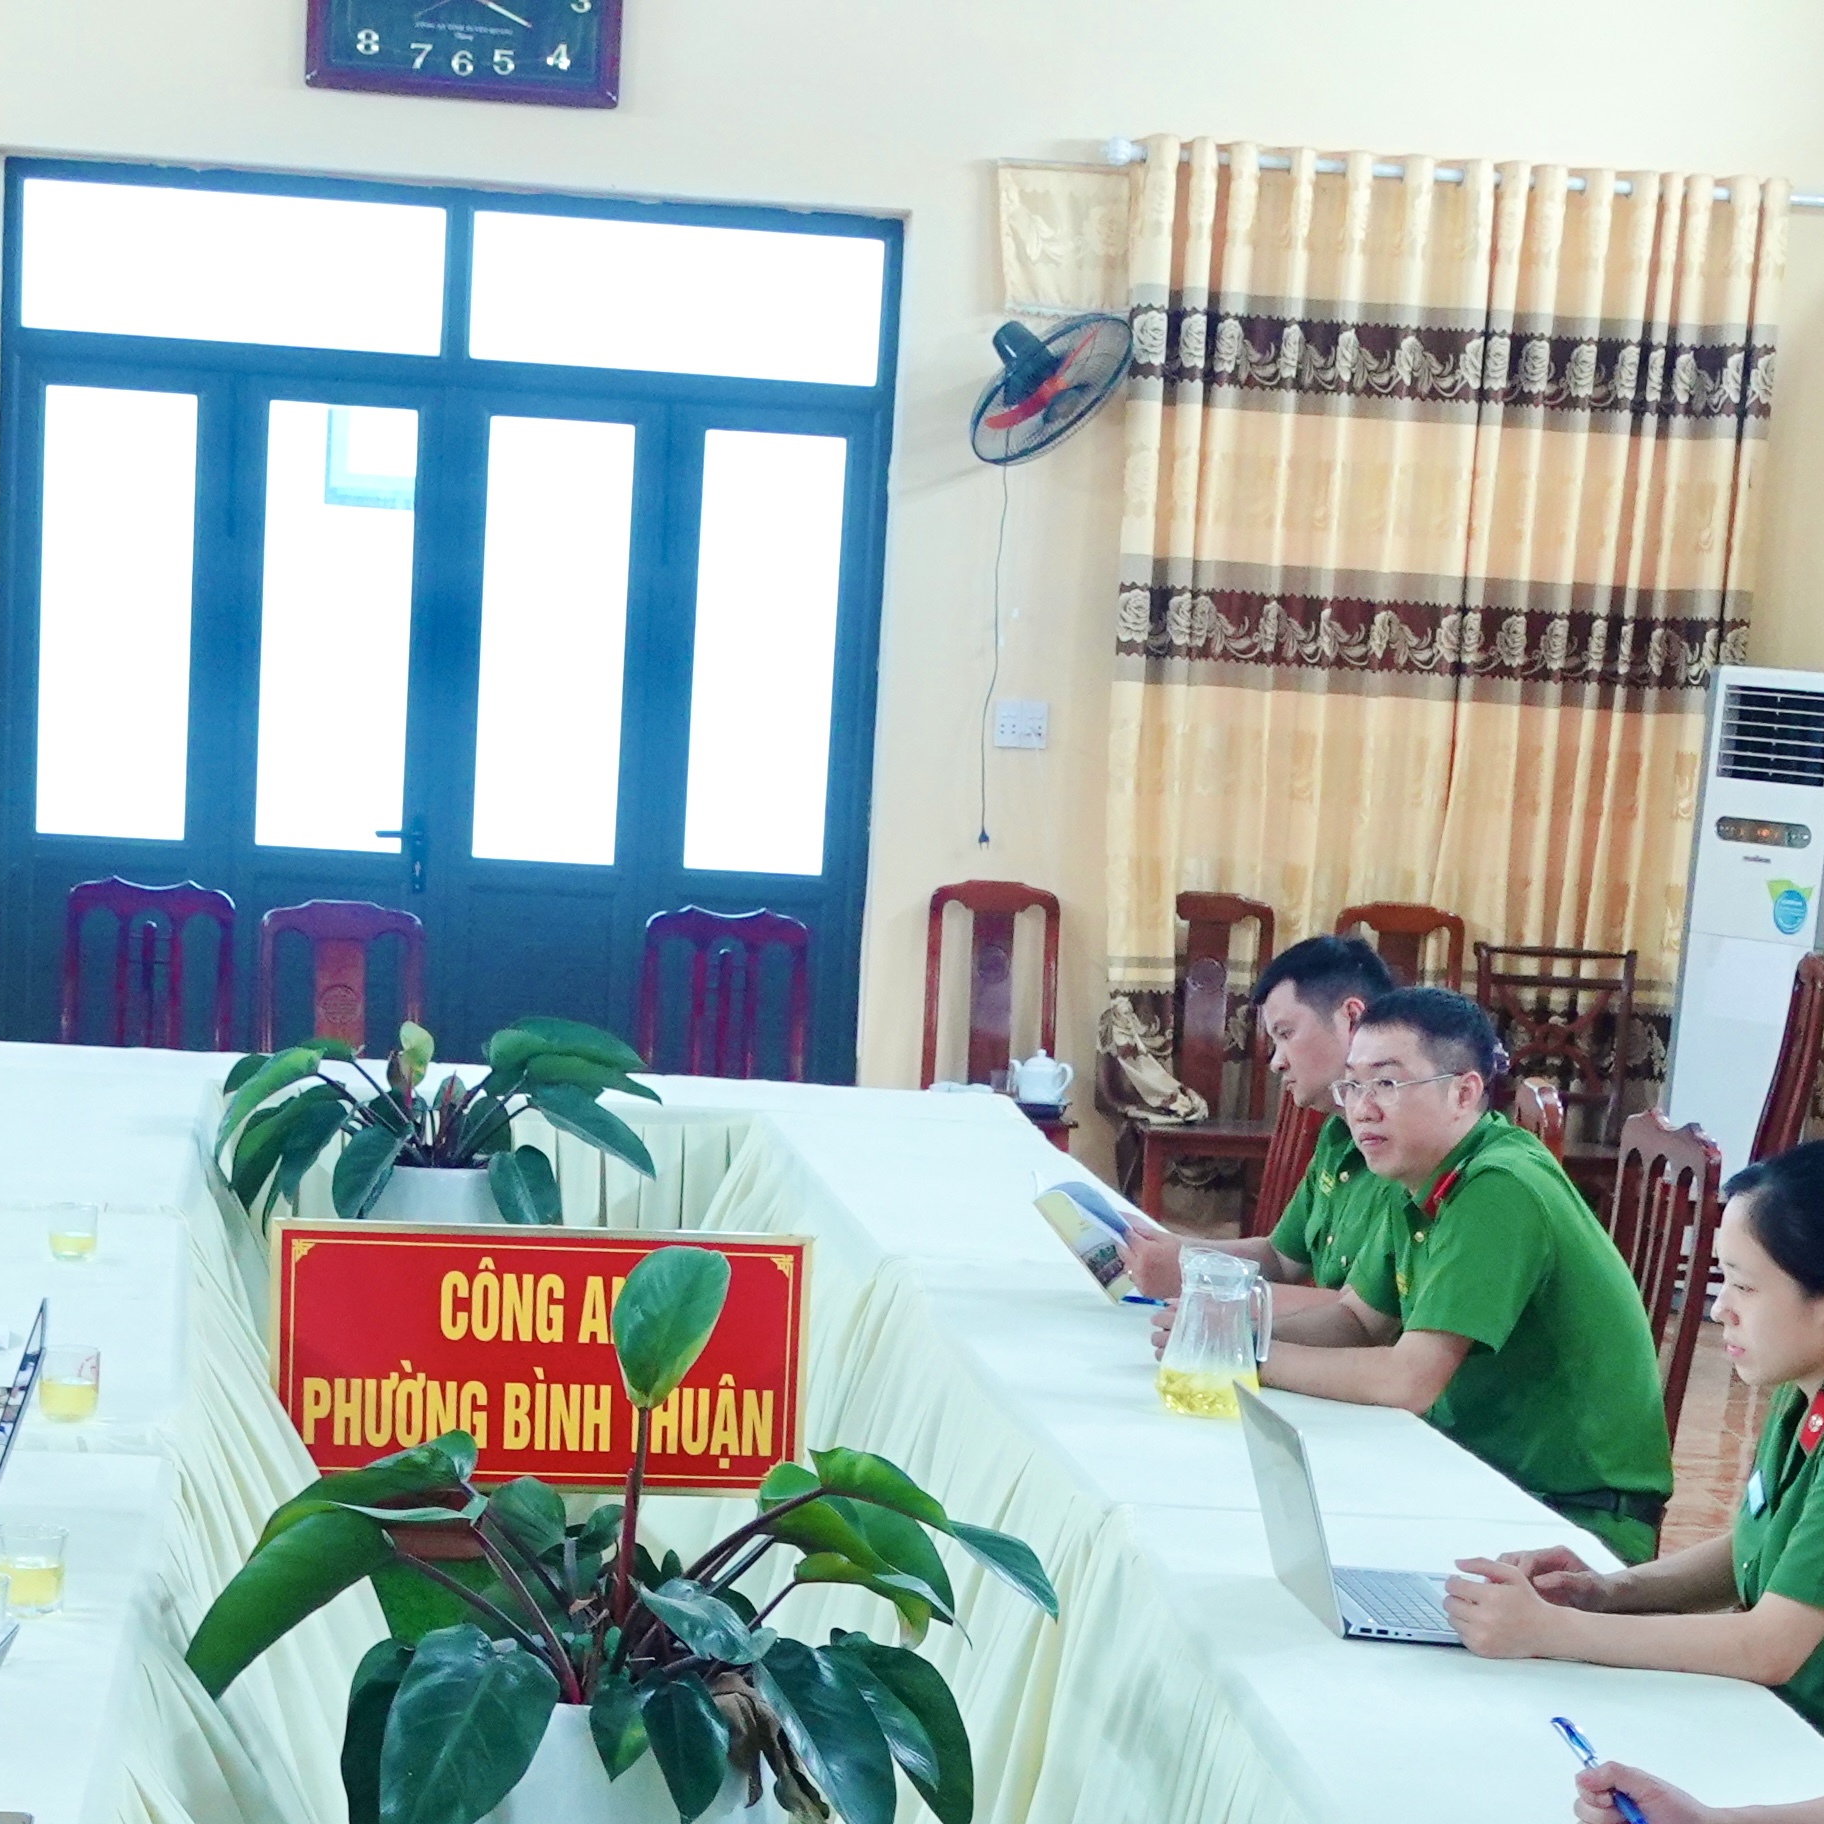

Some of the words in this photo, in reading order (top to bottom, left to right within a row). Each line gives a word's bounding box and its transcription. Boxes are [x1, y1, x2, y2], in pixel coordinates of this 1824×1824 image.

[356, 28, 380, 55] 8
[409, 43, 433, 69] 7
[451, 50, 474, 76] 6
[492, 49, 515, 75] 5
[546, 43, 571, 71] 4
[440, 1257, 566, 1343] CÔNG
[302, 1360, 488, 1449] PHƯỜNG
[503, 1366, 613, 1452] BÌNH
